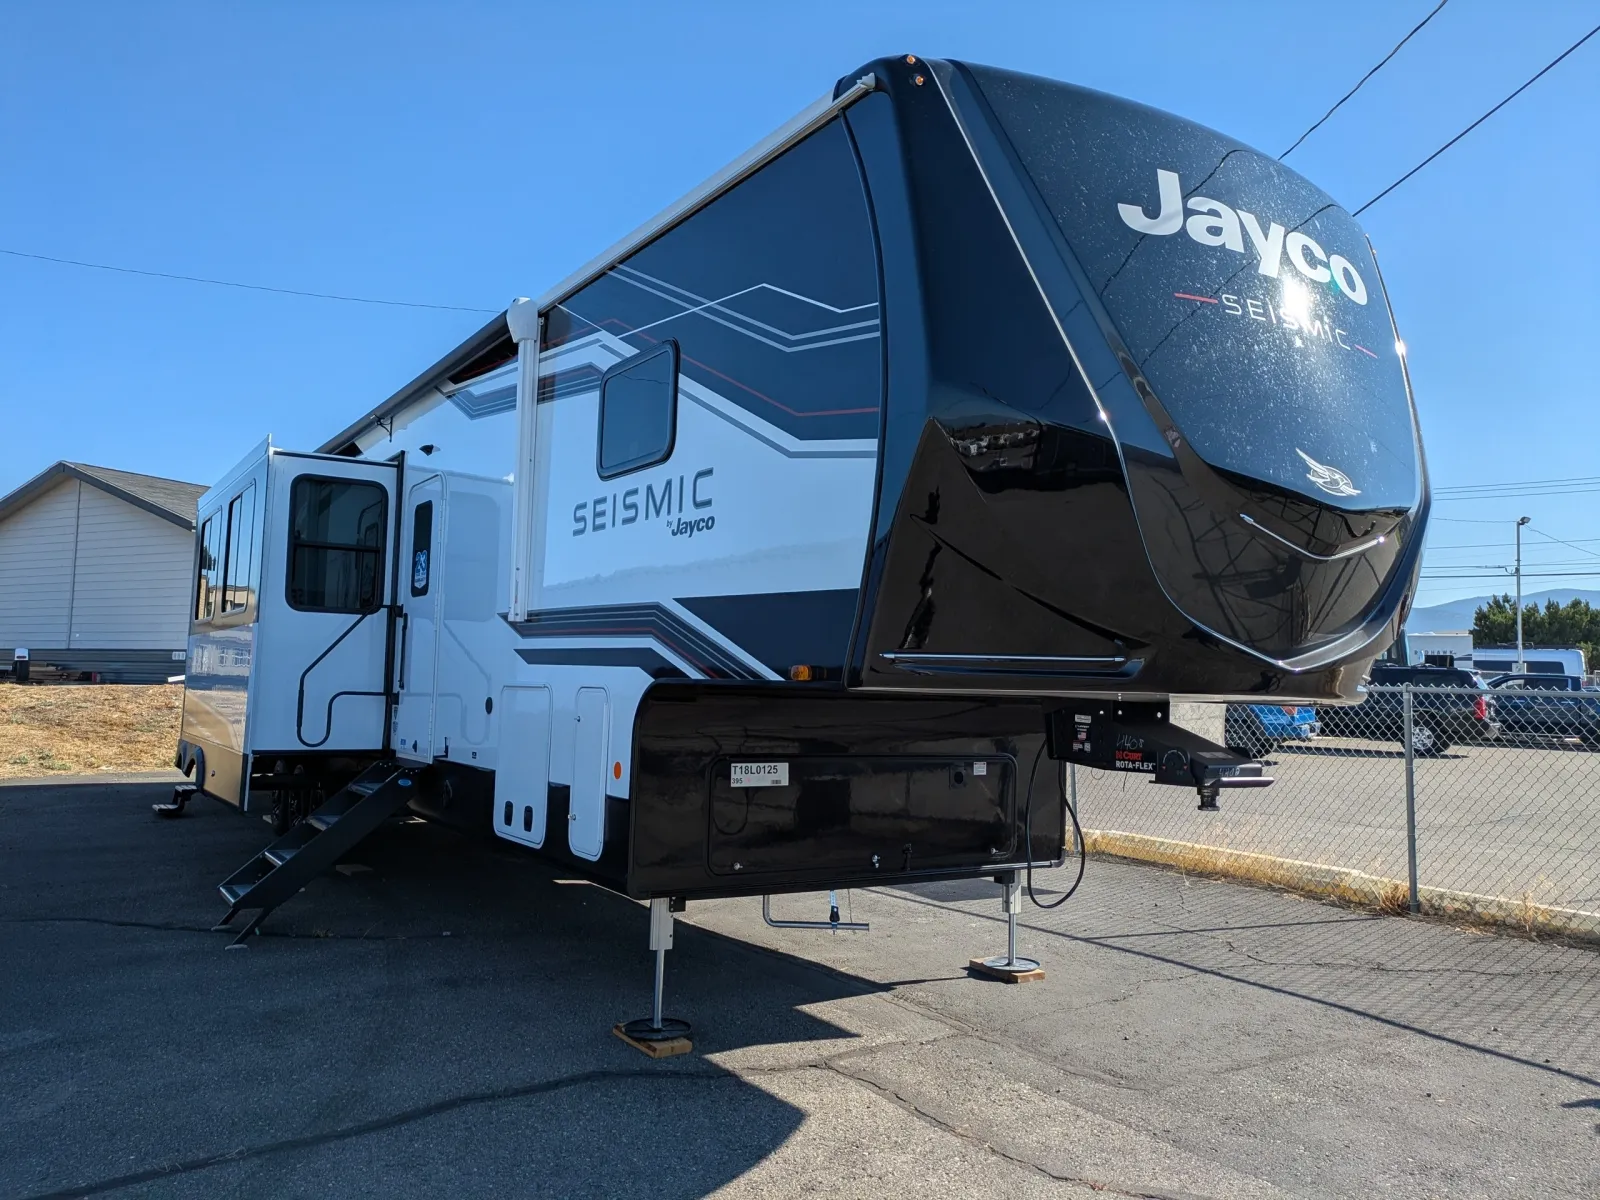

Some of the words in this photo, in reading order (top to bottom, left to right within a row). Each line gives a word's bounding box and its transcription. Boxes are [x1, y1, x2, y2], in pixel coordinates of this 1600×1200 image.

[1117, 168, 1368, 306] Jayco
[1222, 294, 1351, 350] SEISMIC
[572, 467, 714, 537] SEISMIC
[666, 519, 673, 528] by
[671, 515, 715, 538] Jayco
[732, 765, 778, 775] T18L0125
